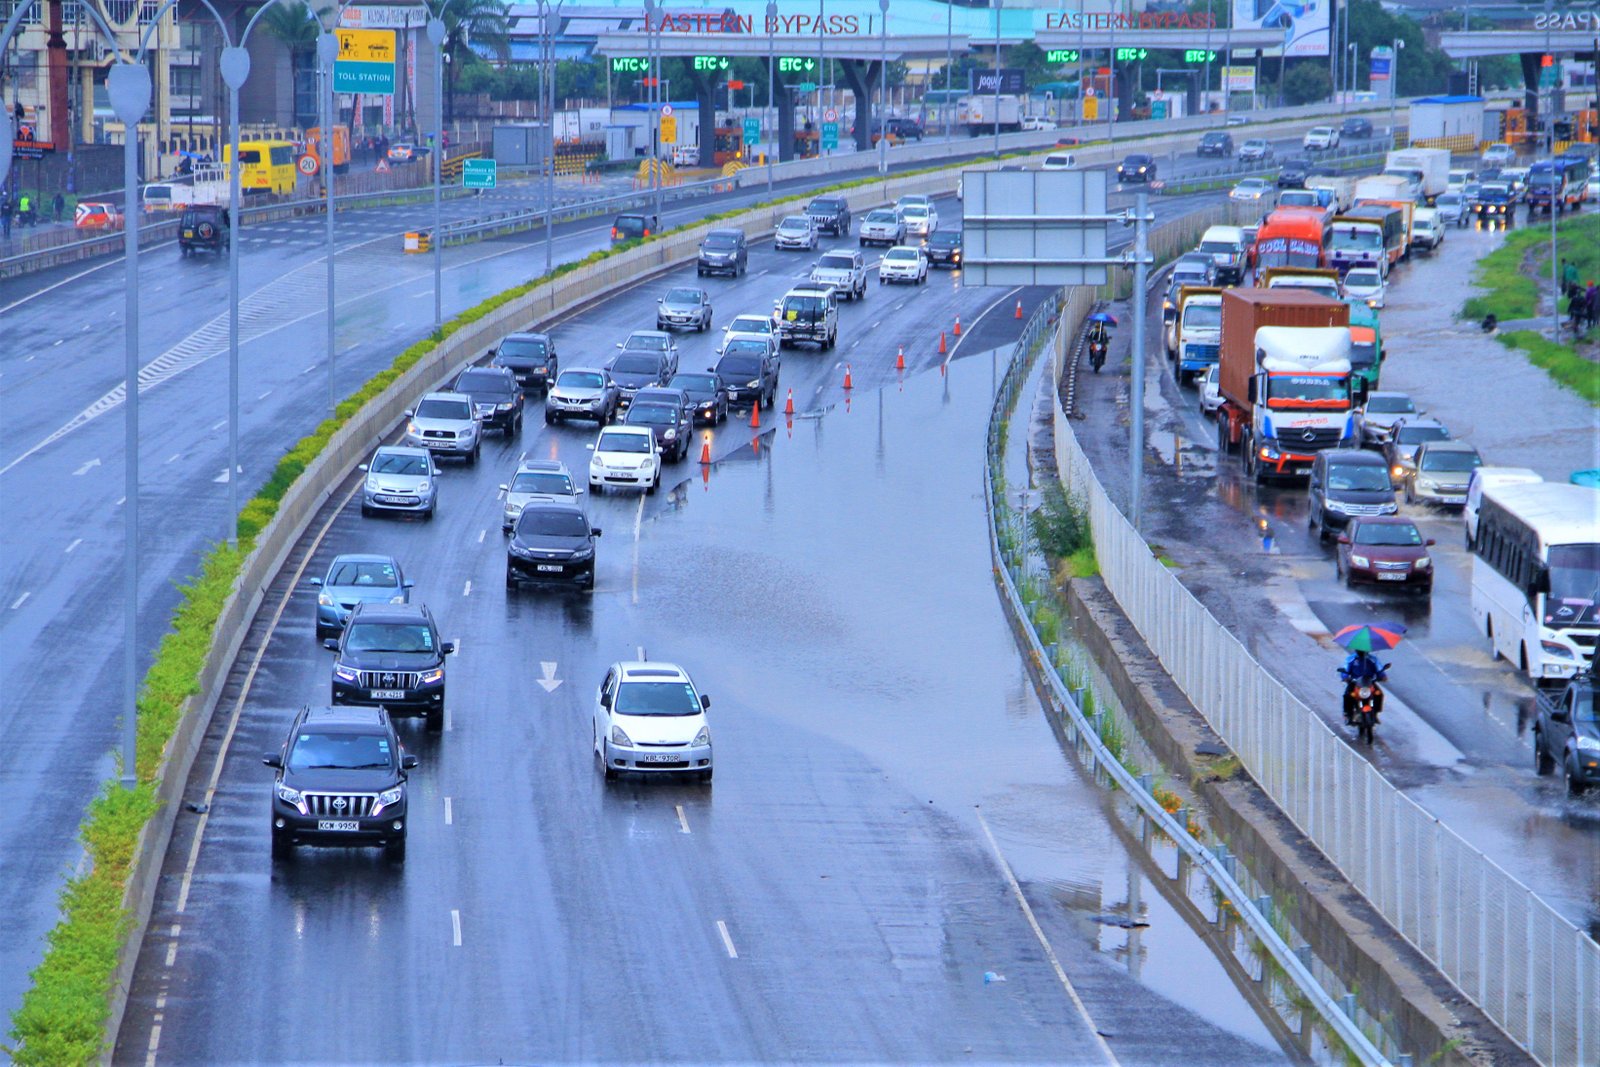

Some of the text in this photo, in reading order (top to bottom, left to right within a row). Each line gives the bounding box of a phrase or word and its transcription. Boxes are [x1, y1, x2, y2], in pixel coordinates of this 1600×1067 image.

[765, 15, 859, 34] BYPASS
[1046, 12, 1217, 29] EASTERN BYPASS
[1047, 50, 1070, 63] MTC
[1117, 48, 1137, 61] ETC
[1185, 50, 1206, 63] ETC
[613, 58, 638, 71] MTC
[694, 57, 717, 70] ETC
[779, 58, 802, 71] ETC
[338, 73, 391, 82] TOLL STATION
[302, 160, 315, 170] 20
